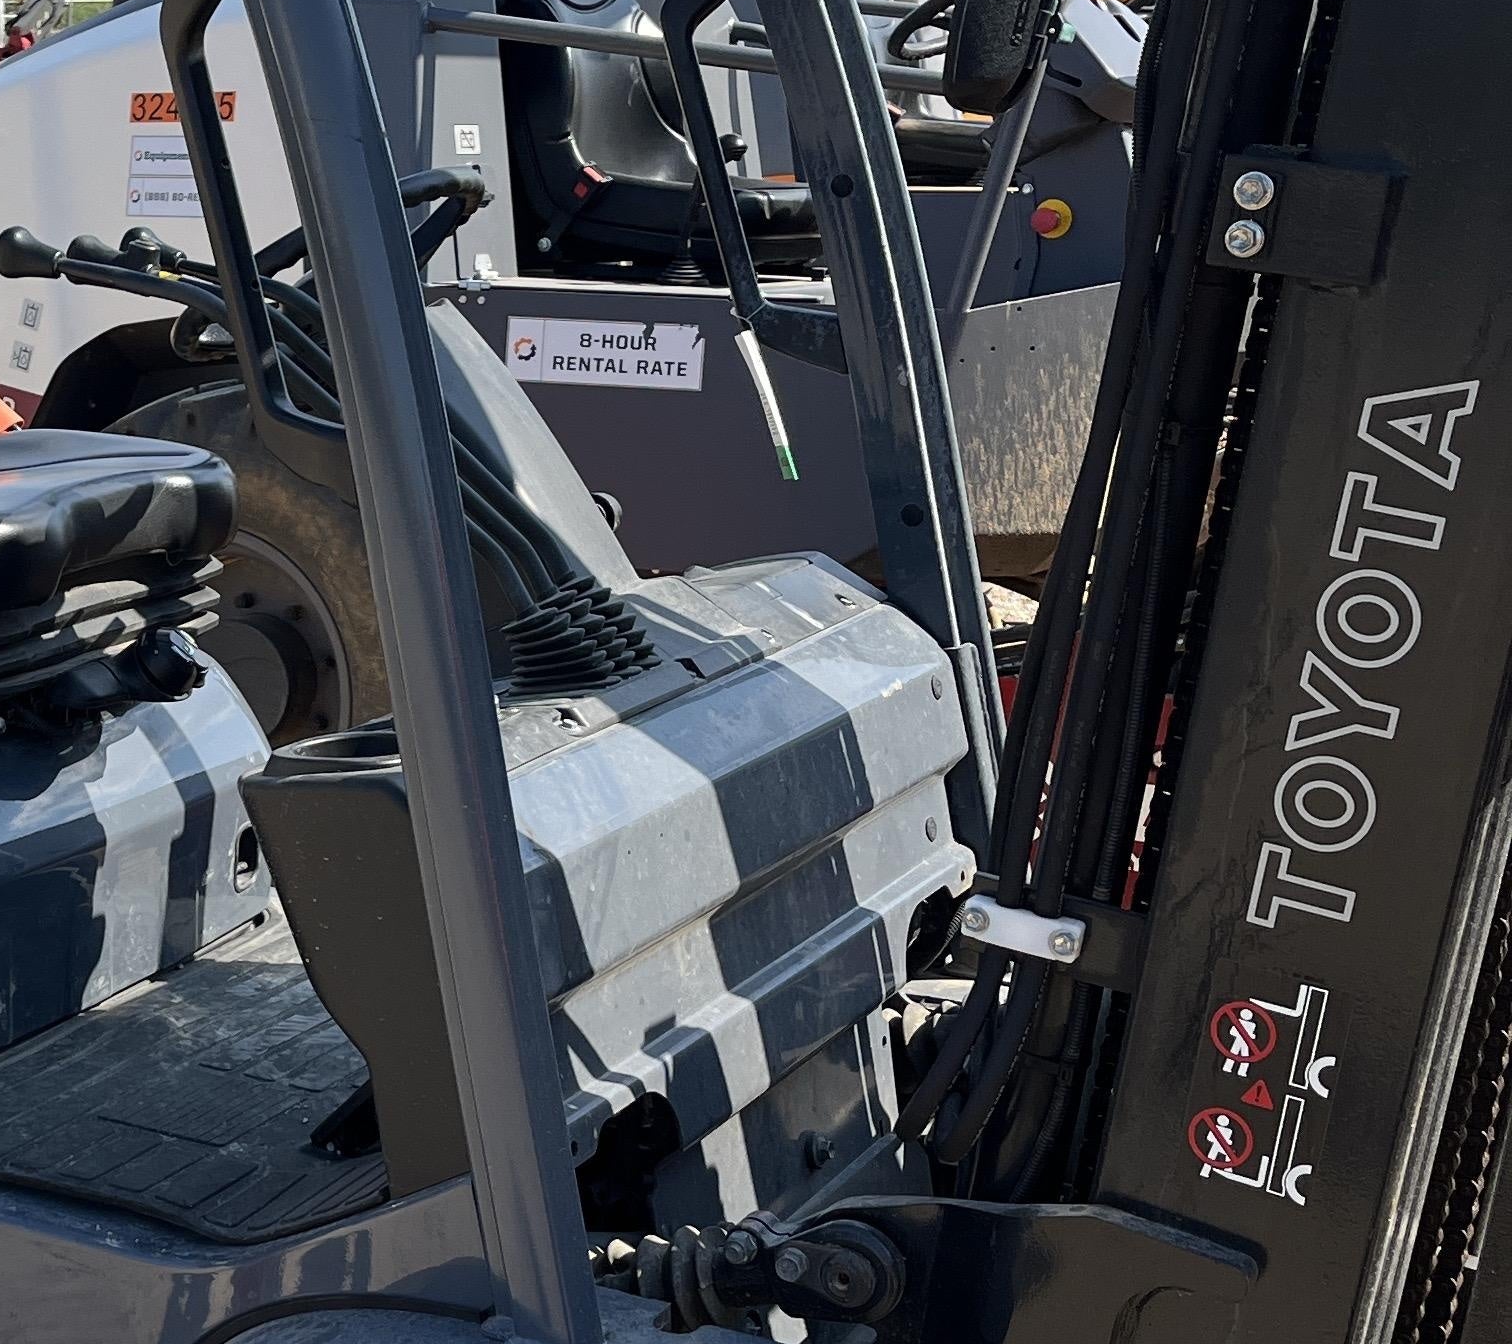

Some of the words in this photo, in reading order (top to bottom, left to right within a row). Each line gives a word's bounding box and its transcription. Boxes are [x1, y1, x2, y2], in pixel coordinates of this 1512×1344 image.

[131, 92, 234, 121] 3245
[578, 333, 657, 352] 8-HOUR
[552, 355, 628, 374] RENTAL
[636, 359, 688, 377] RATE
[1247, 379, 1480, 929] TOYOTA
